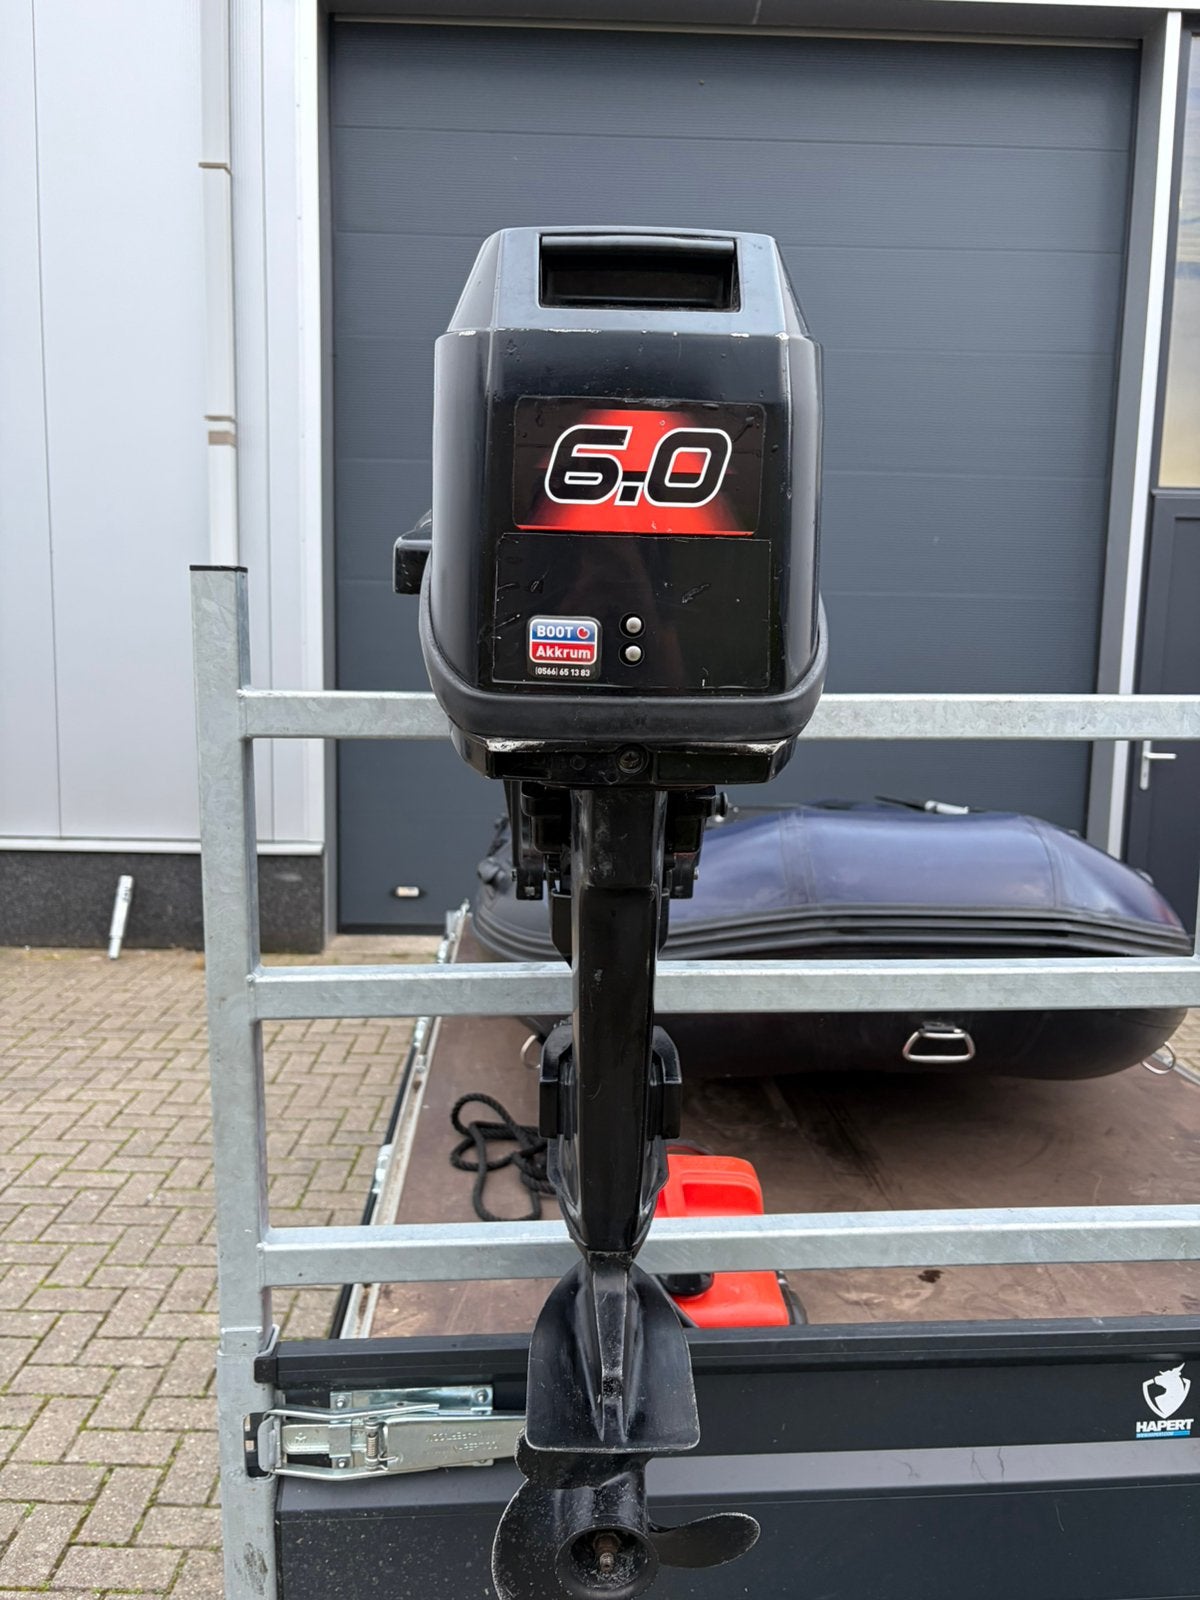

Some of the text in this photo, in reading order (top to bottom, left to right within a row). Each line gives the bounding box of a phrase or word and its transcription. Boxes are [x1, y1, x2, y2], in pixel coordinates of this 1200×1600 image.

[544, 424, 733, 508] 6.0
[537, 625, 573, 638] BOOT
[536, 645, 591, 659] Akkrum
[535, 666, 590, 677] (0566) 65 13 83
[1136, 1418, 1194, 1432] HAPERT
